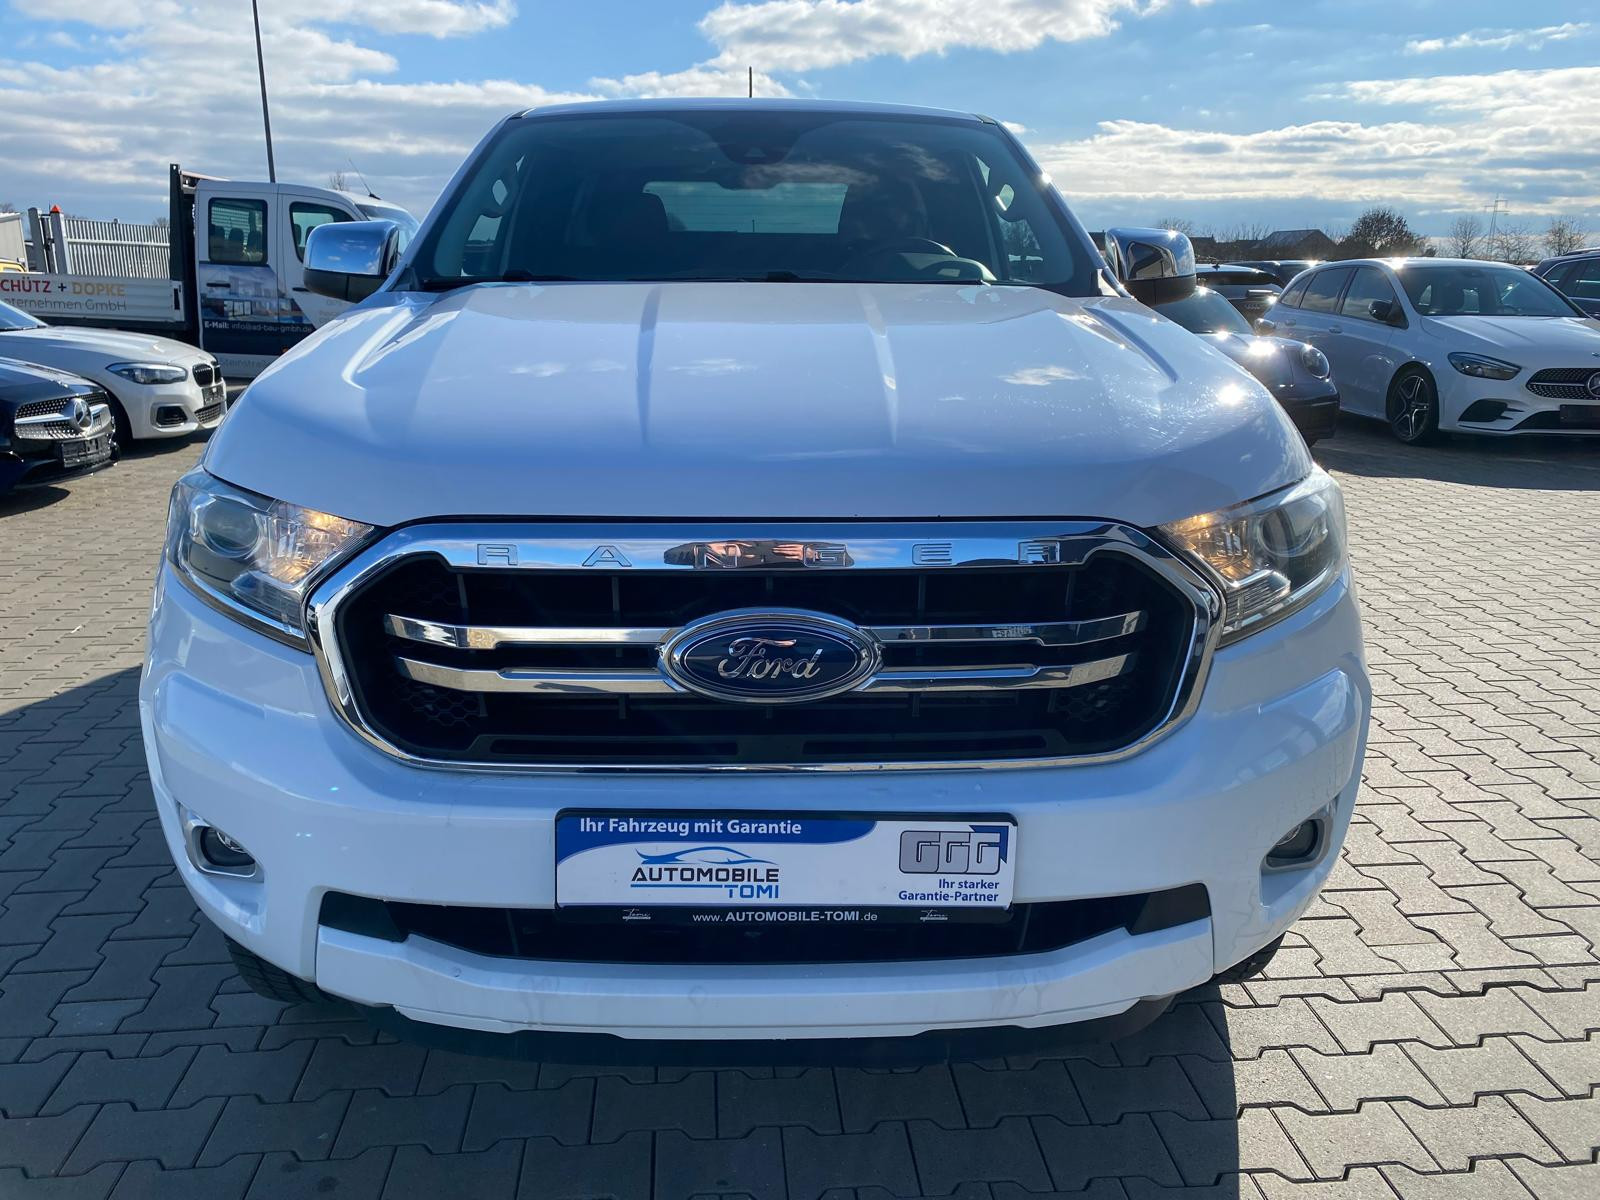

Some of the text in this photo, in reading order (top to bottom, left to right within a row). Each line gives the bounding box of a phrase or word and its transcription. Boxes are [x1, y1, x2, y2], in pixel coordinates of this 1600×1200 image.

[58, 282, 67, 292] +
[85, 298, 127, 312] GmbH
[204, 320, 229, 330] E-Mail:
[476, 540, 1061, 568] RANGER
[717, 636, 824, 679] Ford
[580, 817, 802, 837] Ihr Fahrzeug mit Garantie
[631, 867, 780, 883] AUTOMOBILE
[724, 884, 780, 899] TOMI
[938, 879, 1000, 890] Ihr starker
[898, 890, 999, 902] Garantie-Partner
